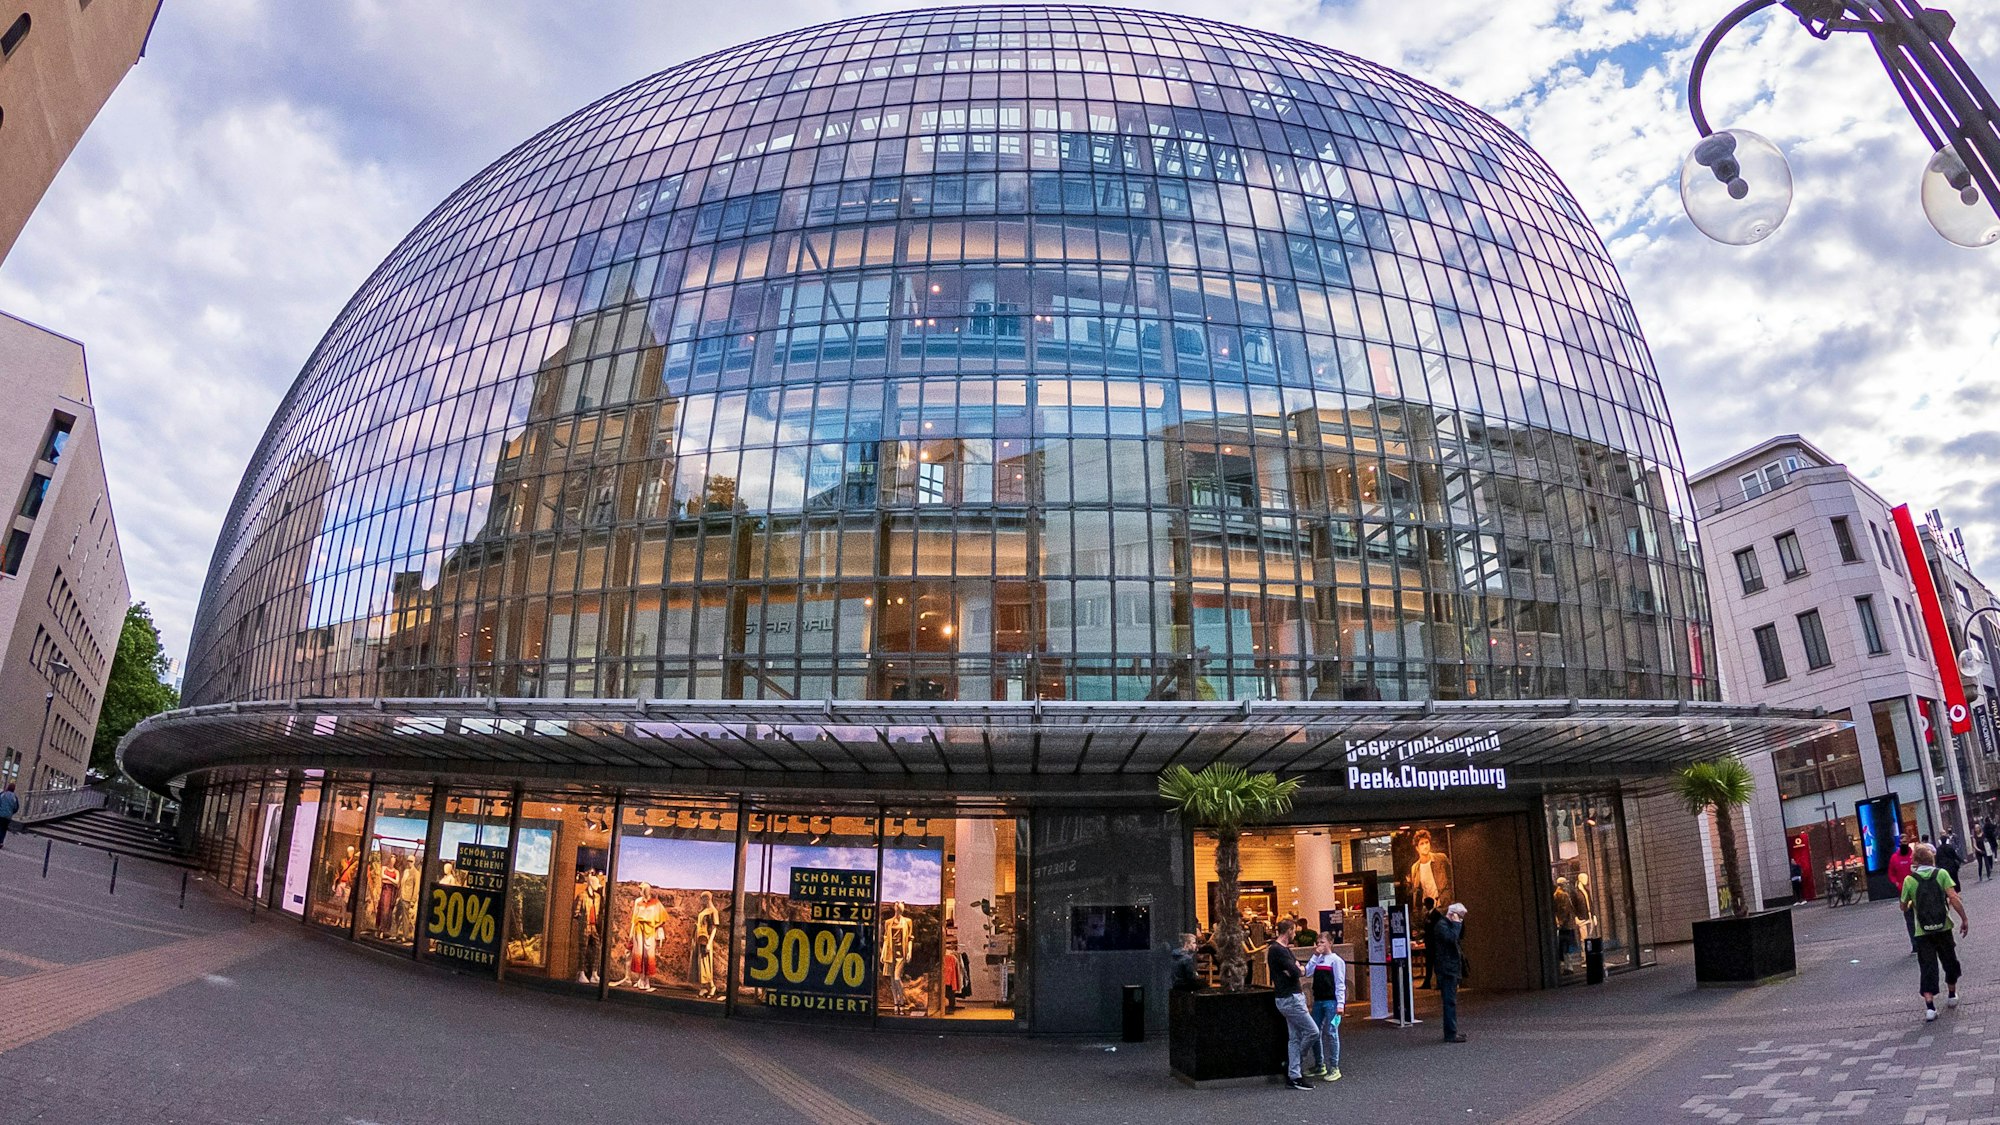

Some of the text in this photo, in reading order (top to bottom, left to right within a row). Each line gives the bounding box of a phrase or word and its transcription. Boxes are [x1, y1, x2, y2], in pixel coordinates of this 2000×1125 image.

[459, 846, 505, 860] SCHÖN, SIE
[462, 857, 504, 870] ZU SEHEN!
[468, 874, 503, 889] BIS ZU
[794, 872, 872, 886] SCHÖN, SIE
[800, 885, 816, 895] ZU
[428, 888, 495, 944] 30%
[813, 906, 872, 920] BIS ZU
[437, 944, 495, 965] REDUZIERT
[750, 926, 865, 988] 30%
[768, 993, 869, 1012] REDUZIERT
